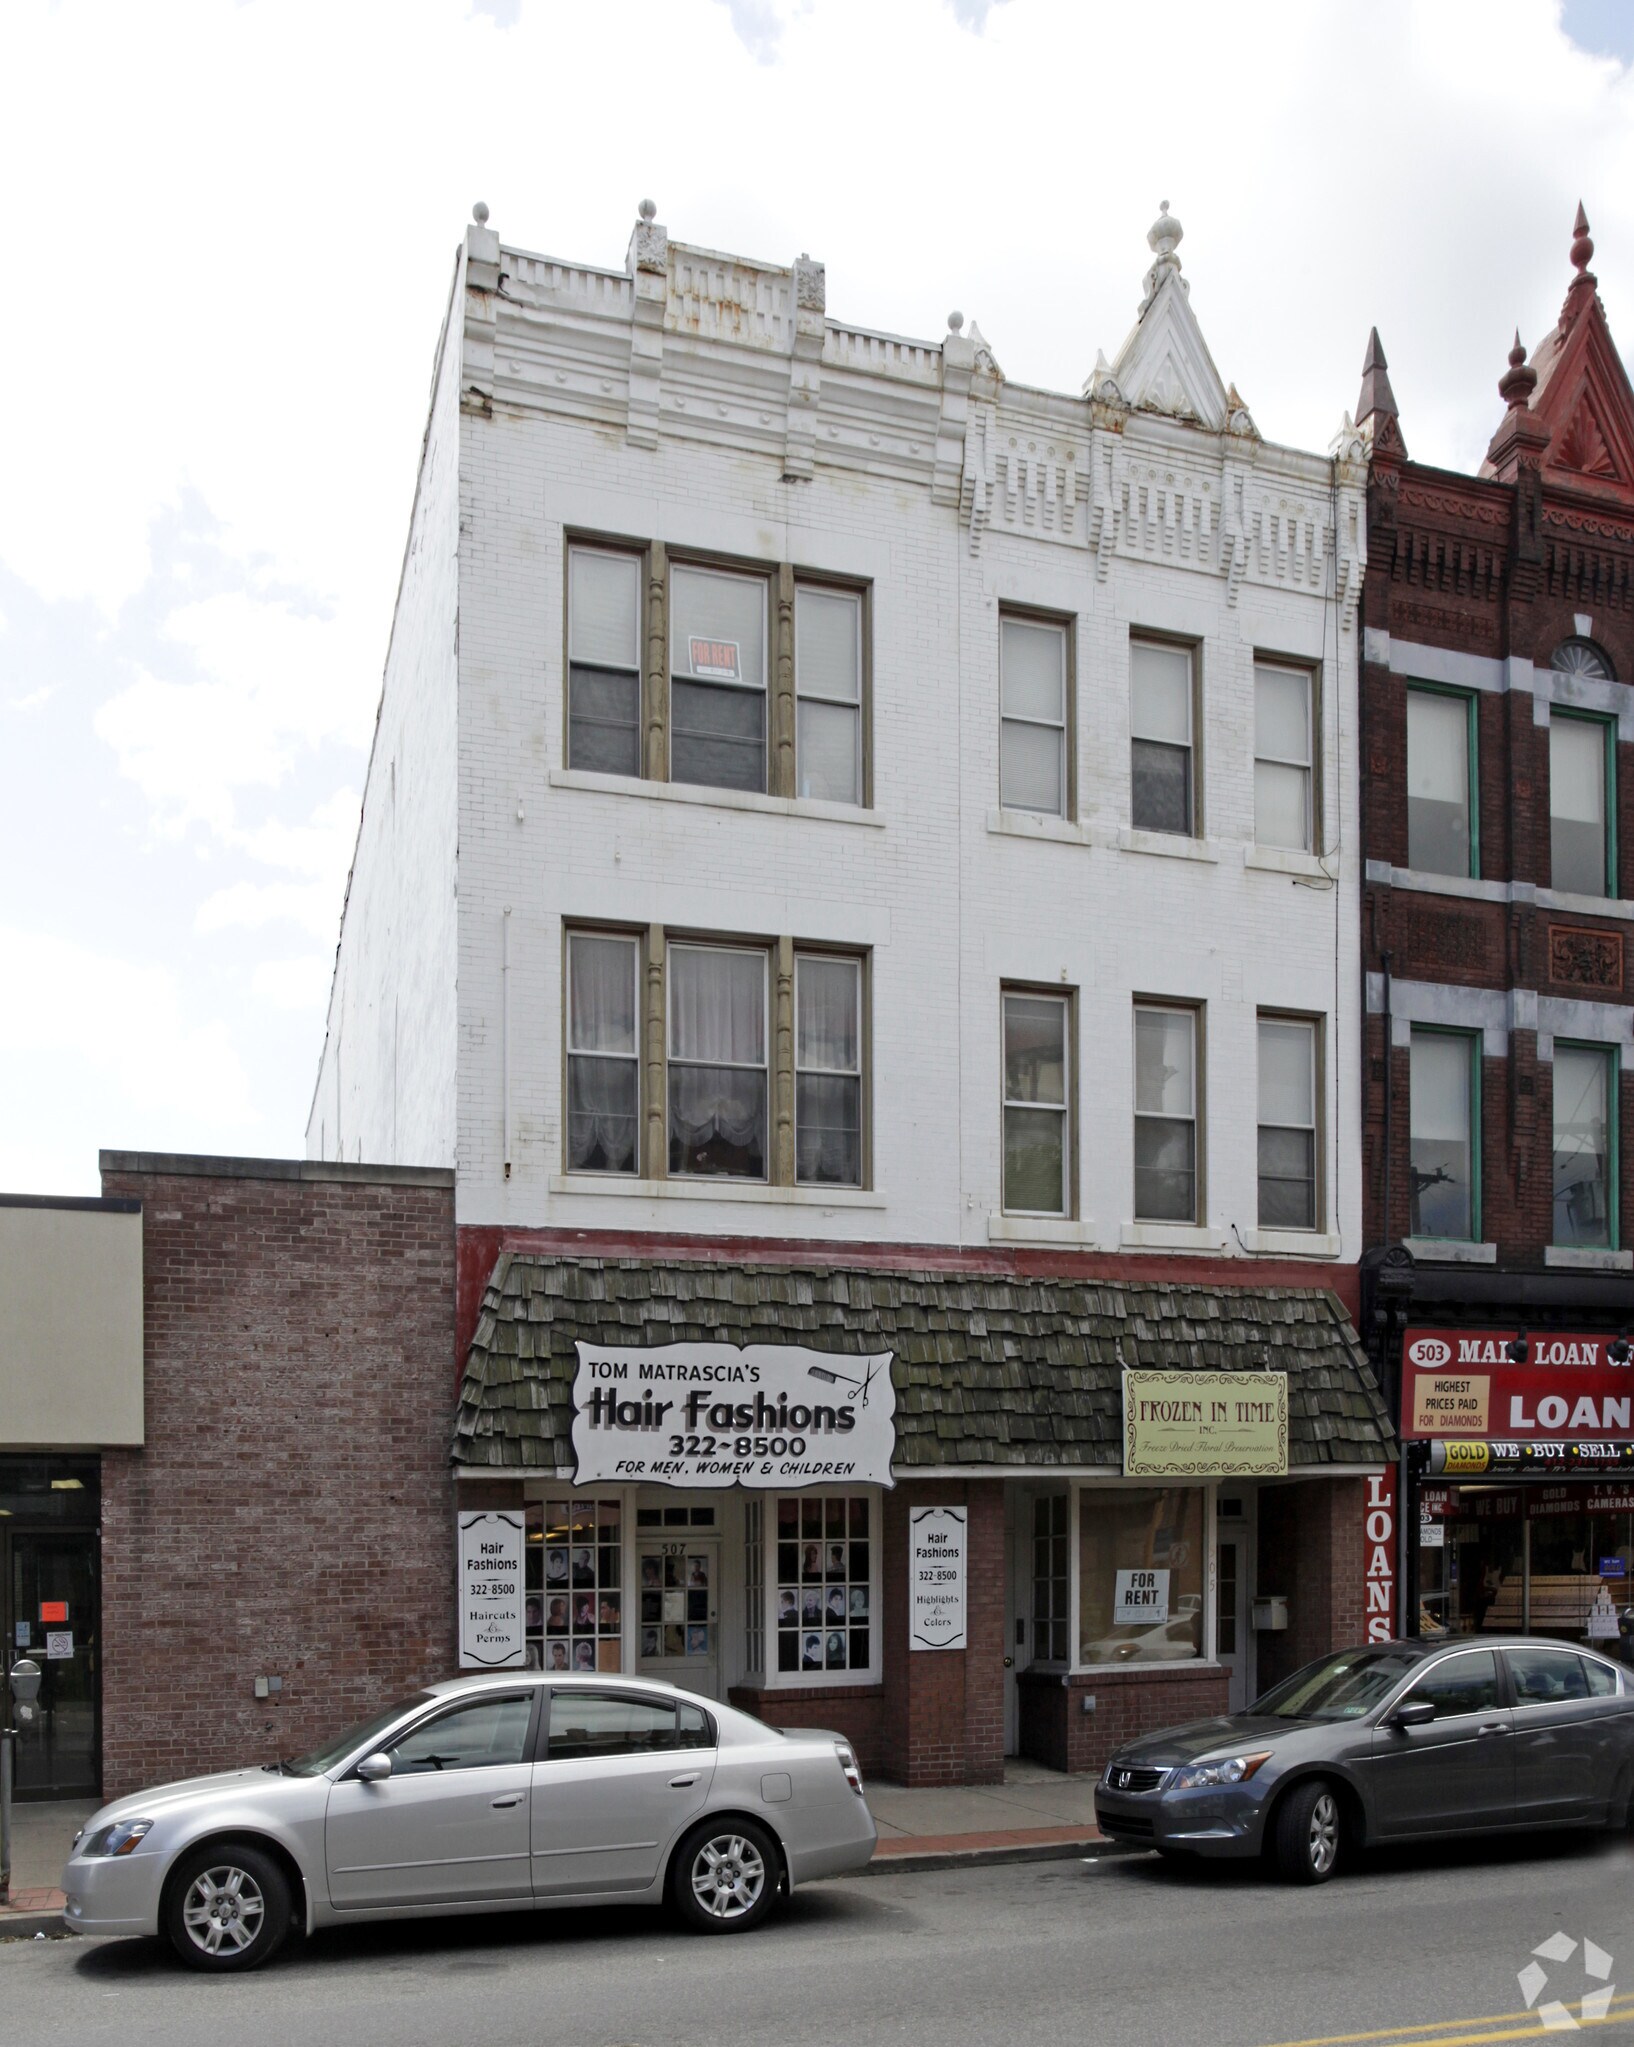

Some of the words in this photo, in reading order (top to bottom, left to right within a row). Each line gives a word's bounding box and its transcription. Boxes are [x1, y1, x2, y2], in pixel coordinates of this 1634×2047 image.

[692, 640, 711, 665] FOR
[711, 642, 736, 669] RENT
[1417, 1344, 1444, 1361] 503
[1458, 1340, 1516, 1363] MAI
[1535, 1342, 1599, 1366] LOAN
[588, 1362, 628, 1379] TOM
[639, 1363, 760, 1382] MATRASCIA'S
[1434, 1381, 1470, 1393] HIGHEST
[586, 1386, 673, 1430] Hair
[683, 1389, 856, 1433] Fashions
[1425, 1398, 1455, 1410] PRICES
[1458, 1398, 1478, 1410] PAID
[1140, 1401, 1202, 1422] FROZEN
[1211, 1402, 1227, 1422] IN
[1235, 1402, 1275, 1422] TIME
[1510, 1395, 1631, 1429] LOAN
[1419, 1415, 1434, 1427] FOR
[1440, 1415, 1482, 1427] DIAMONDS
[1199, 1426, 1217, 1435] INC.
[1139, 1441, 1168, 1452] Freeze
[1169, 1441, 1194, 1452] Dried
[1194, 1441, 1223, 1452] Floral
[1224, 1441, 1275, 1452] Preservation
[1450, 1444, 1485, 1460] GOLD
[1491, 1443, 1520, 1457] WE
[1531, 1443, 1565, 1457] BUY
[1579, 1443, 1620, 1457] SELL
[615, 1461, 645, 1474] FOR
[696, 1461, 755, 1475] WOMEN
[760, 1462, 773, 1475] &
[780, 1462, 855, 1475] CHILDREN
[1446, 1461, 1486, 1470] DIAMONDS
[1425, 1491, 1447, 1502] LOAN
[1543, 1488, 1567, 1500] GOLD
[1476, 1499, 1491, 1515] WE
[1496, 1497, 1518, 1514] BUY
[1530, 1501, 1580, 1515] DIAMONDS
[1587, 1497, 1634, 1509] CAMERAS
[1420, 1514, 1430, 1522] 03
[928, 1532, 948, 1544] Hair
[480, 1542, 504, 1554] Hair
[661, 1543, 687, 1555] 507
[916, 1547, 959, 1559] Fashions
[467, 1559, 518, 1570] Fashions
[1366, 1476, 1392, 1644] LOANS
[919, 1570, 957, 1581] 322-8500
[1131, 1573, 1155, 1588] FOR
[470, 1584, 515, 1595] 322-8500
[917, 1595, 959, 1605] Highlights
[1125, 1590, 1159, 1605] RENT
[470, 1611, 516, 1620] Haircuts
[924, 1617, 951, 1627] Colors
[476, 1634, 511, 1643] Perms
